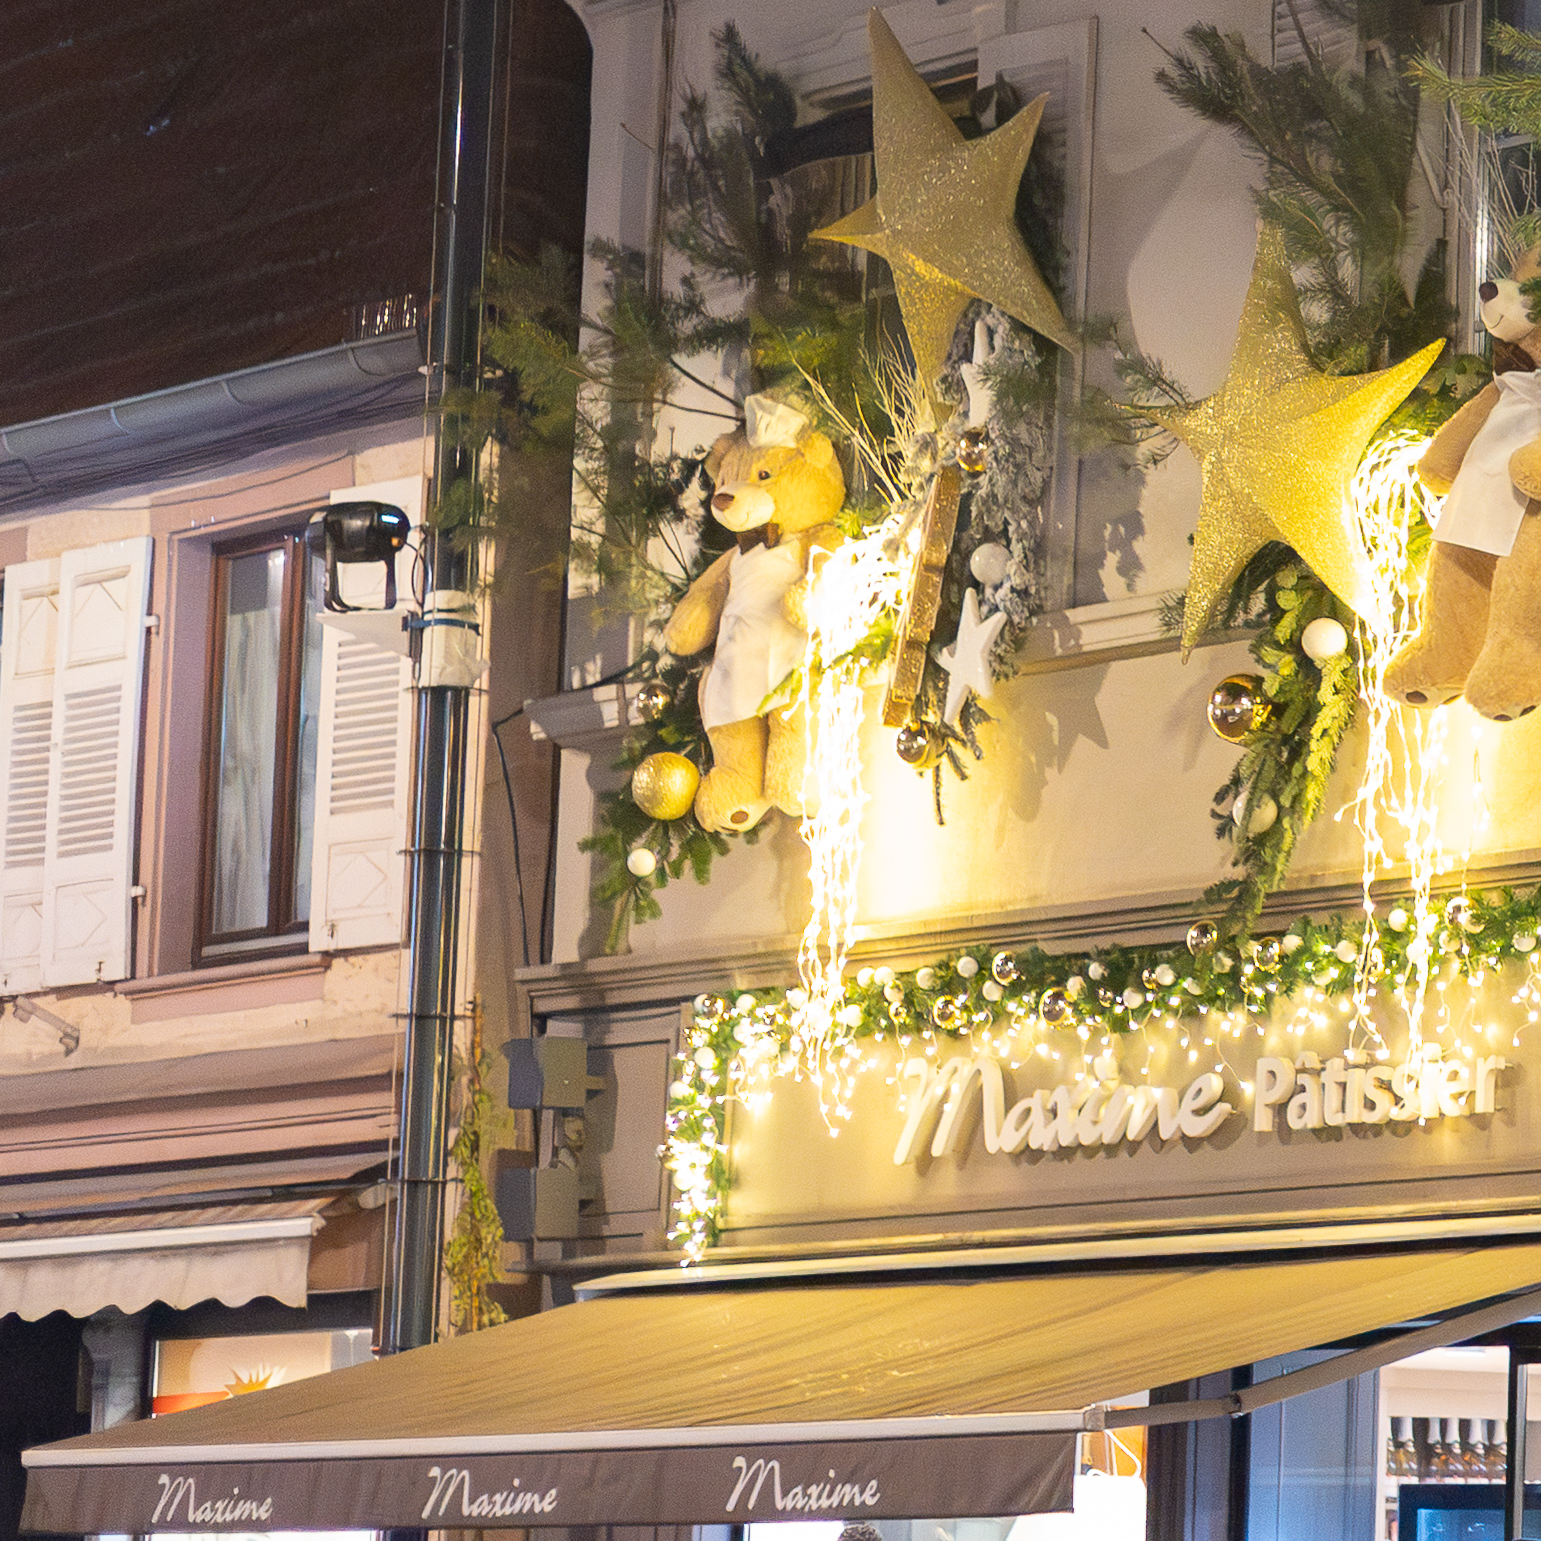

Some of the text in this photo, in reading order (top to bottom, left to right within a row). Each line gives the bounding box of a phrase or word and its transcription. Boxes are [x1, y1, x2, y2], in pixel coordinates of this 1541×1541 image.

[893, 1042, 1506, 1165] Maxime Pâtissier
[151, 1455, 881, 1524] Maxime Maxime Maxime
